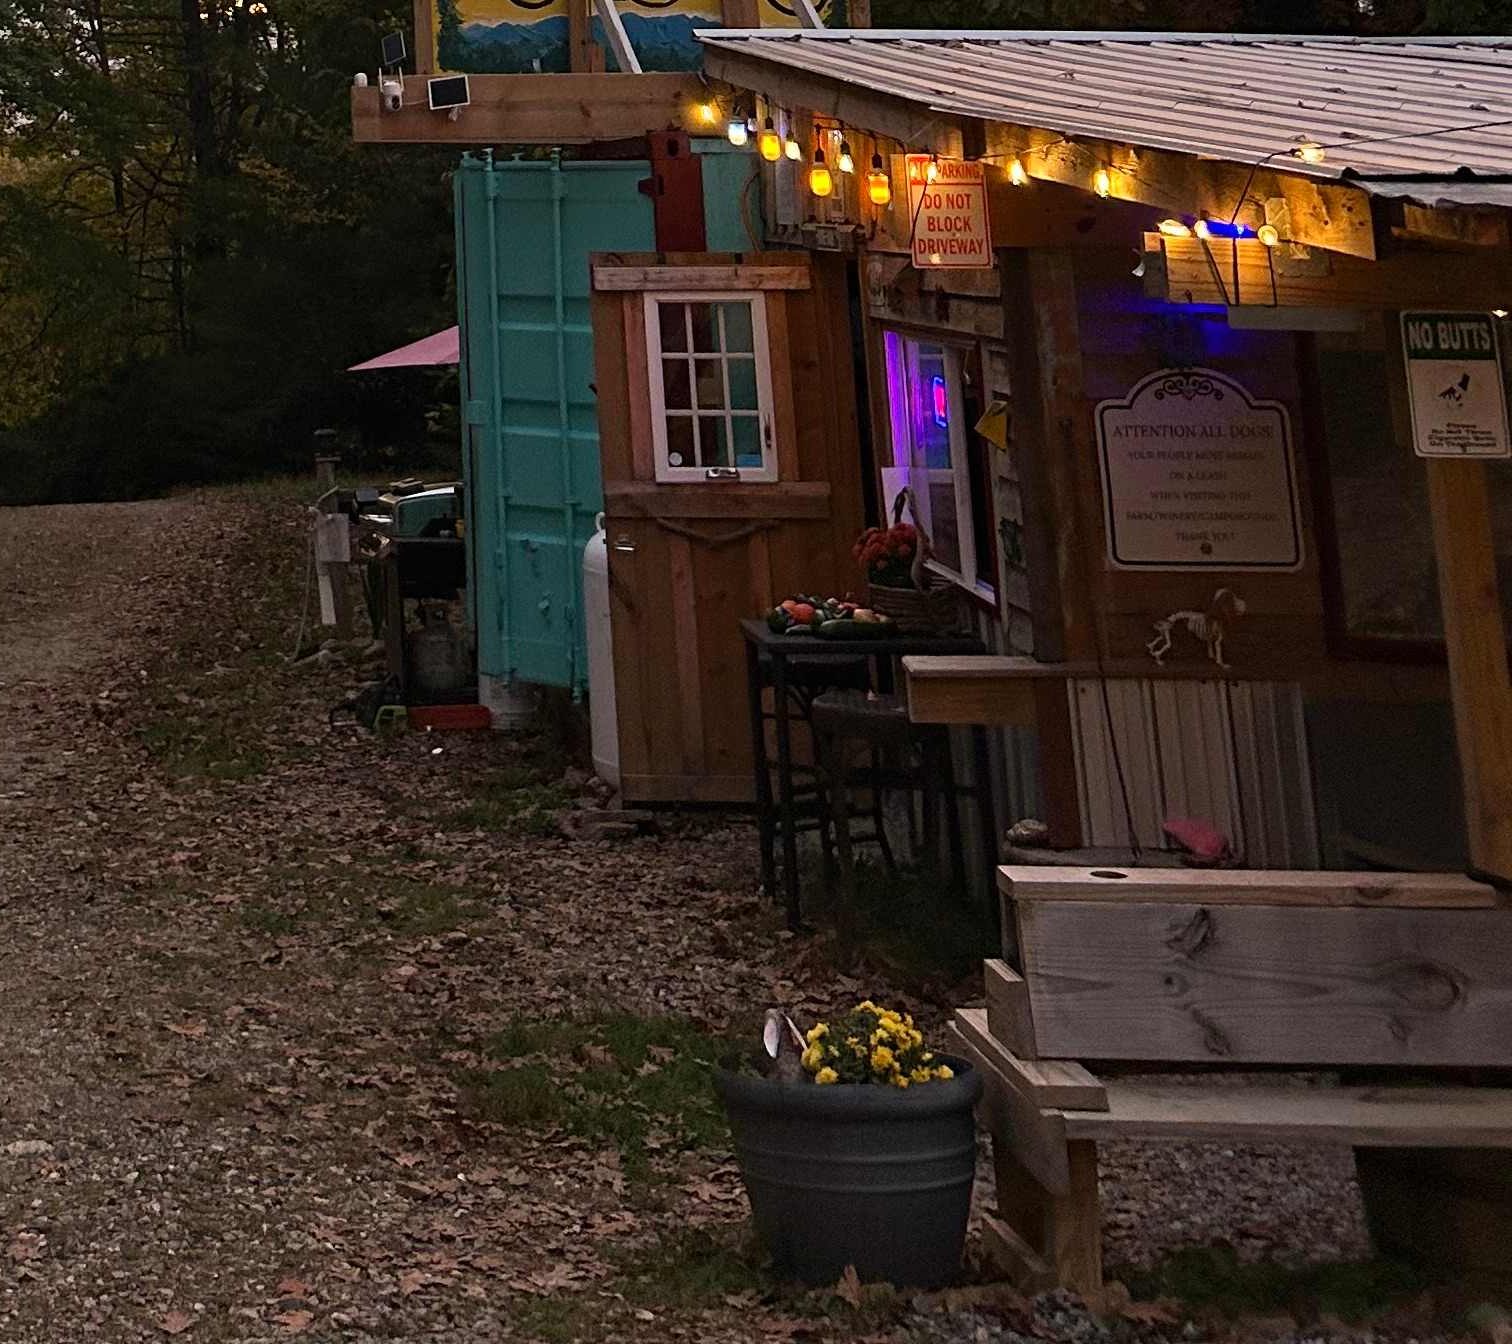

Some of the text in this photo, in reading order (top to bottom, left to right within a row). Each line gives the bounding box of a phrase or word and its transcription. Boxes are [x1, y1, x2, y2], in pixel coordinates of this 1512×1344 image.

[923, 193, 972, 210] DO NOT
[927, 215, 972, 233] BLOCK
[918, 238, 984, 256] DRIVEWAY
[1408, 321, 1491, 351] NO BUTTS
[1112, 424, 1196, 439] ATTENTION
[1197, 424, 1227, 439] ALL
